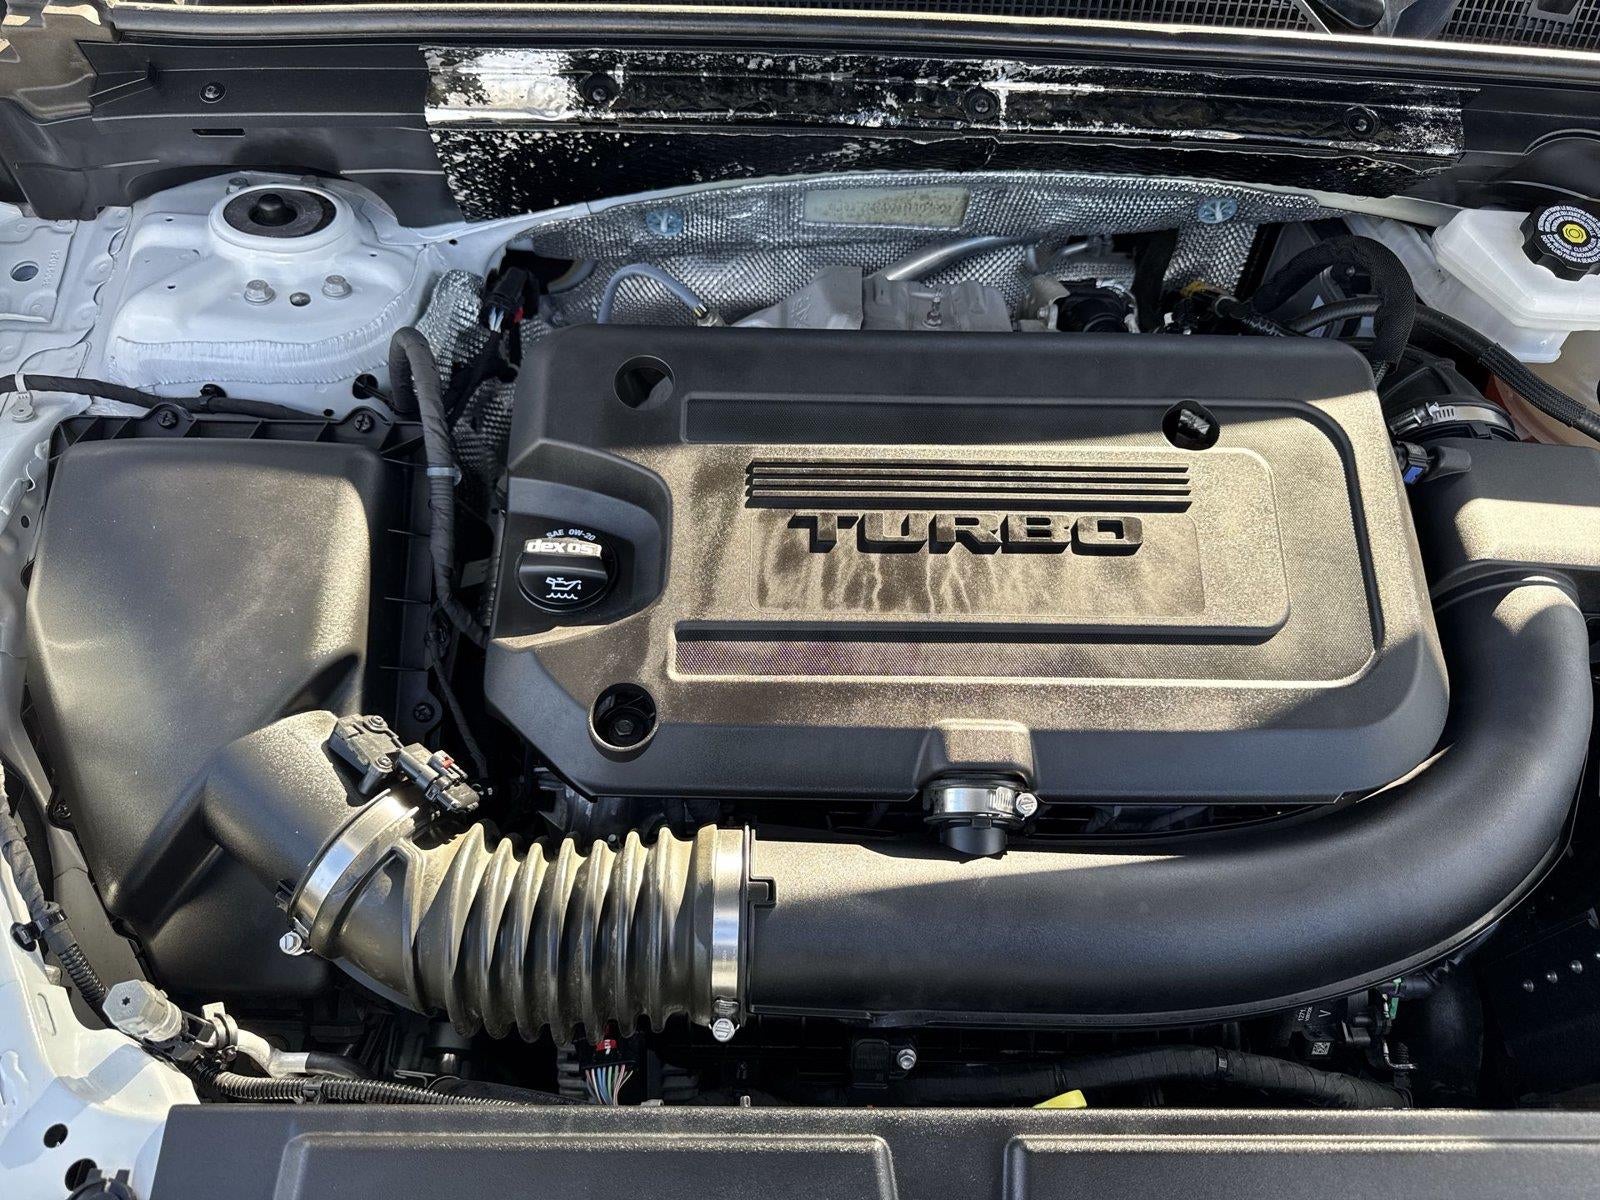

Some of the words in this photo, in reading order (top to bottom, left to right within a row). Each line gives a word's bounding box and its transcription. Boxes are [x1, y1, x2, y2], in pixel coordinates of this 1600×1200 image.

[1562, 253, 1577, 262] FROM
[546, 529, 565, 539] SAE
[568, 528, 596, 541] 0W-20
[787, 511, 1143, 556] TURBO
